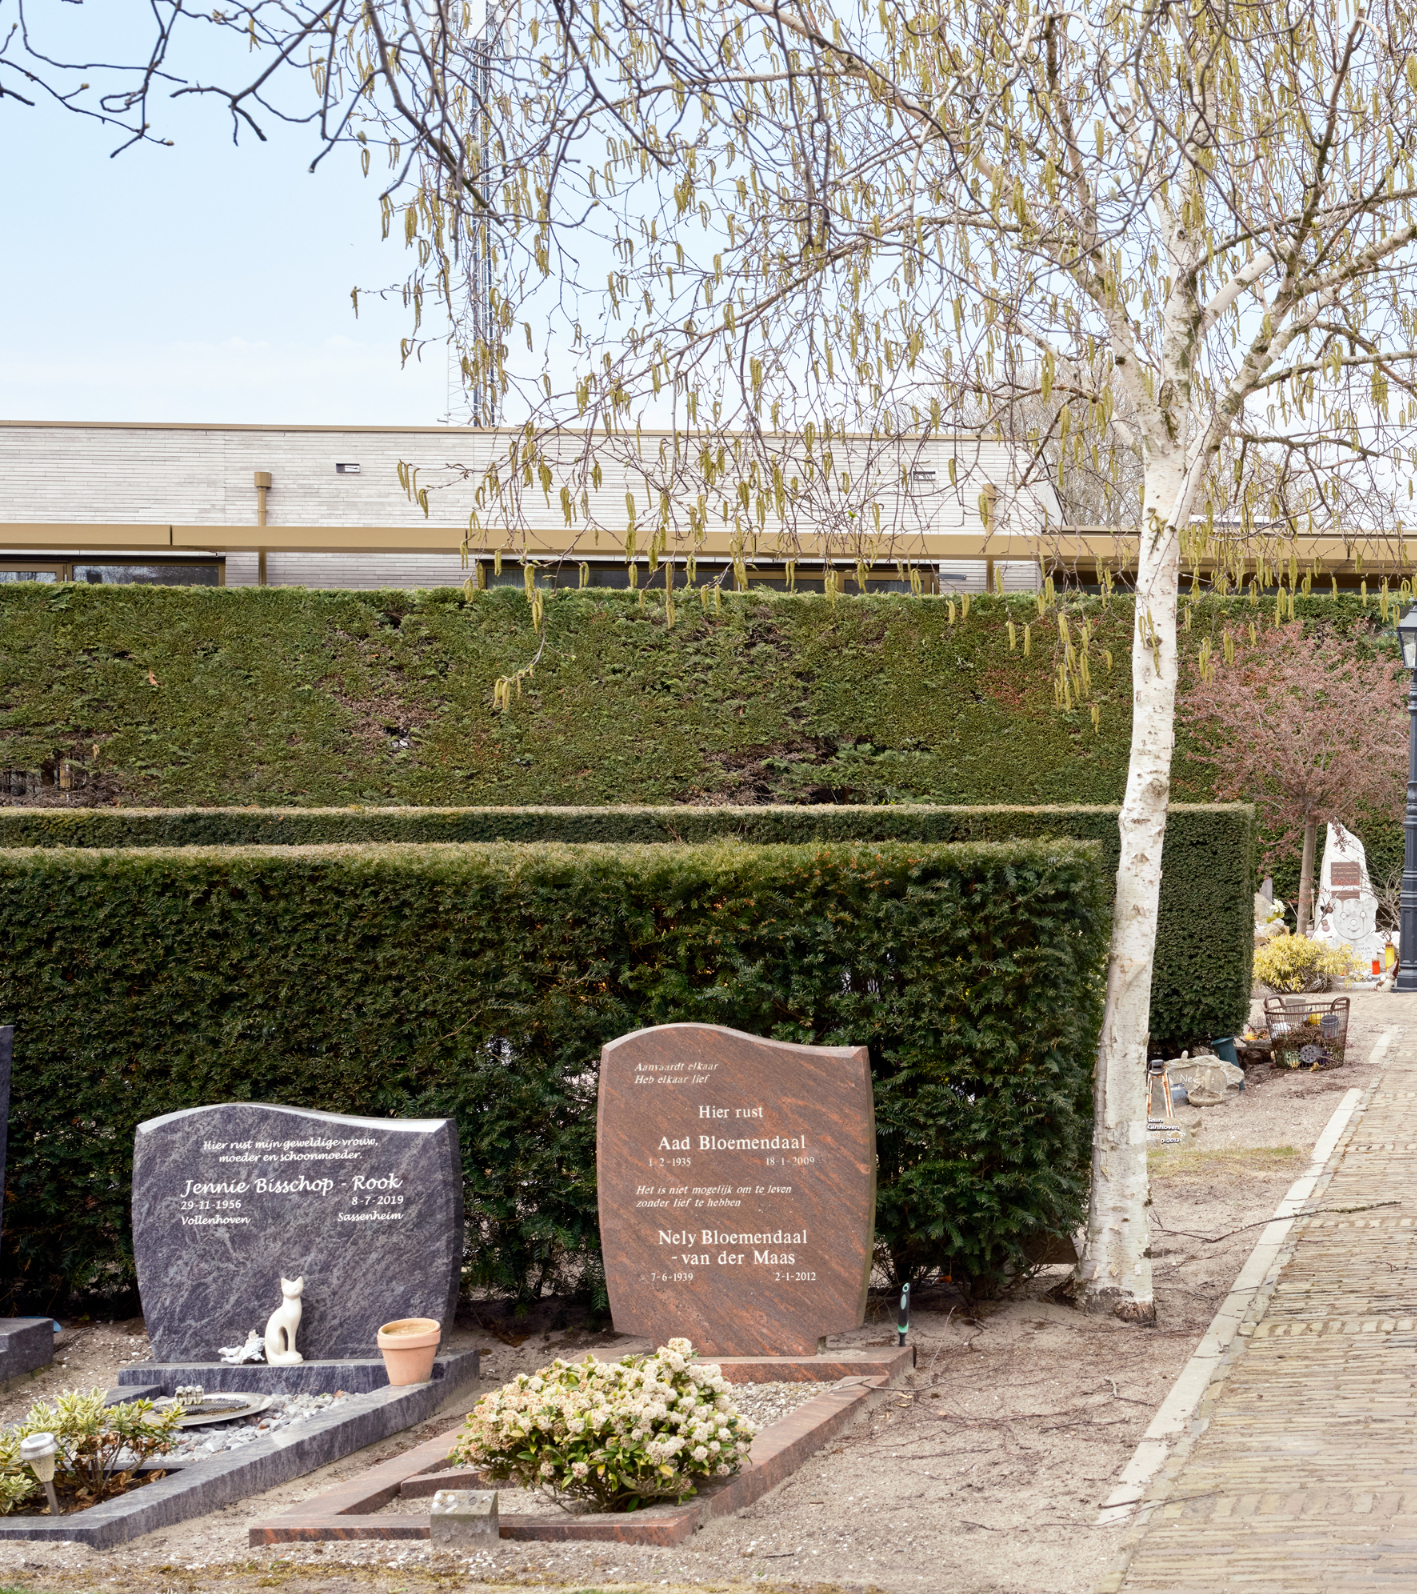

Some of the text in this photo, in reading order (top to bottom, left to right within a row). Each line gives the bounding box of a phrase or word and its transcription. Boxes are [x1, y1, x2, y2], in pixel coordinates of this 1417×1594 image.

[634, 1061, 719, 1072] Aanvaardt elkaar
[634, 1074, 711, 1084] Heb elkaar lief
[698, 1105, 764, 1119] Hier rust
[203, 1137, 379, 1151] Hier rust mijn geweldige vrouw,
[658, 1135, 806, 1150] Aad Bloemendaal
[218, 1150, 363, 1163] moeder en schoonmoeder.
[180, 1179, 250, 1198] Jennie
[254, 1174, 334, 1197] Bisschop
[351, 1172, 404, 1191] Rook
[636, 1184, 792, 1196] Het is niet mogelijk om te leven
[181, 1200, 242, 1210] 29-11-1956
[636, 1198, 741, 1208] zonder lief te hebben
[181, 1215, 250, 1226] Vollenhoven
[337, 1210, 404, 1222] Sassenheim
[658, 1229, 808, 1248] Nely Bloemendaal
[717, 1250, 745, 1265] der
[753, 1249, 796, 1265] Maas
[650, 1272, 694, 1282] 7-6-1939
[775, 1271, 817, 1282] 2-1-2012
